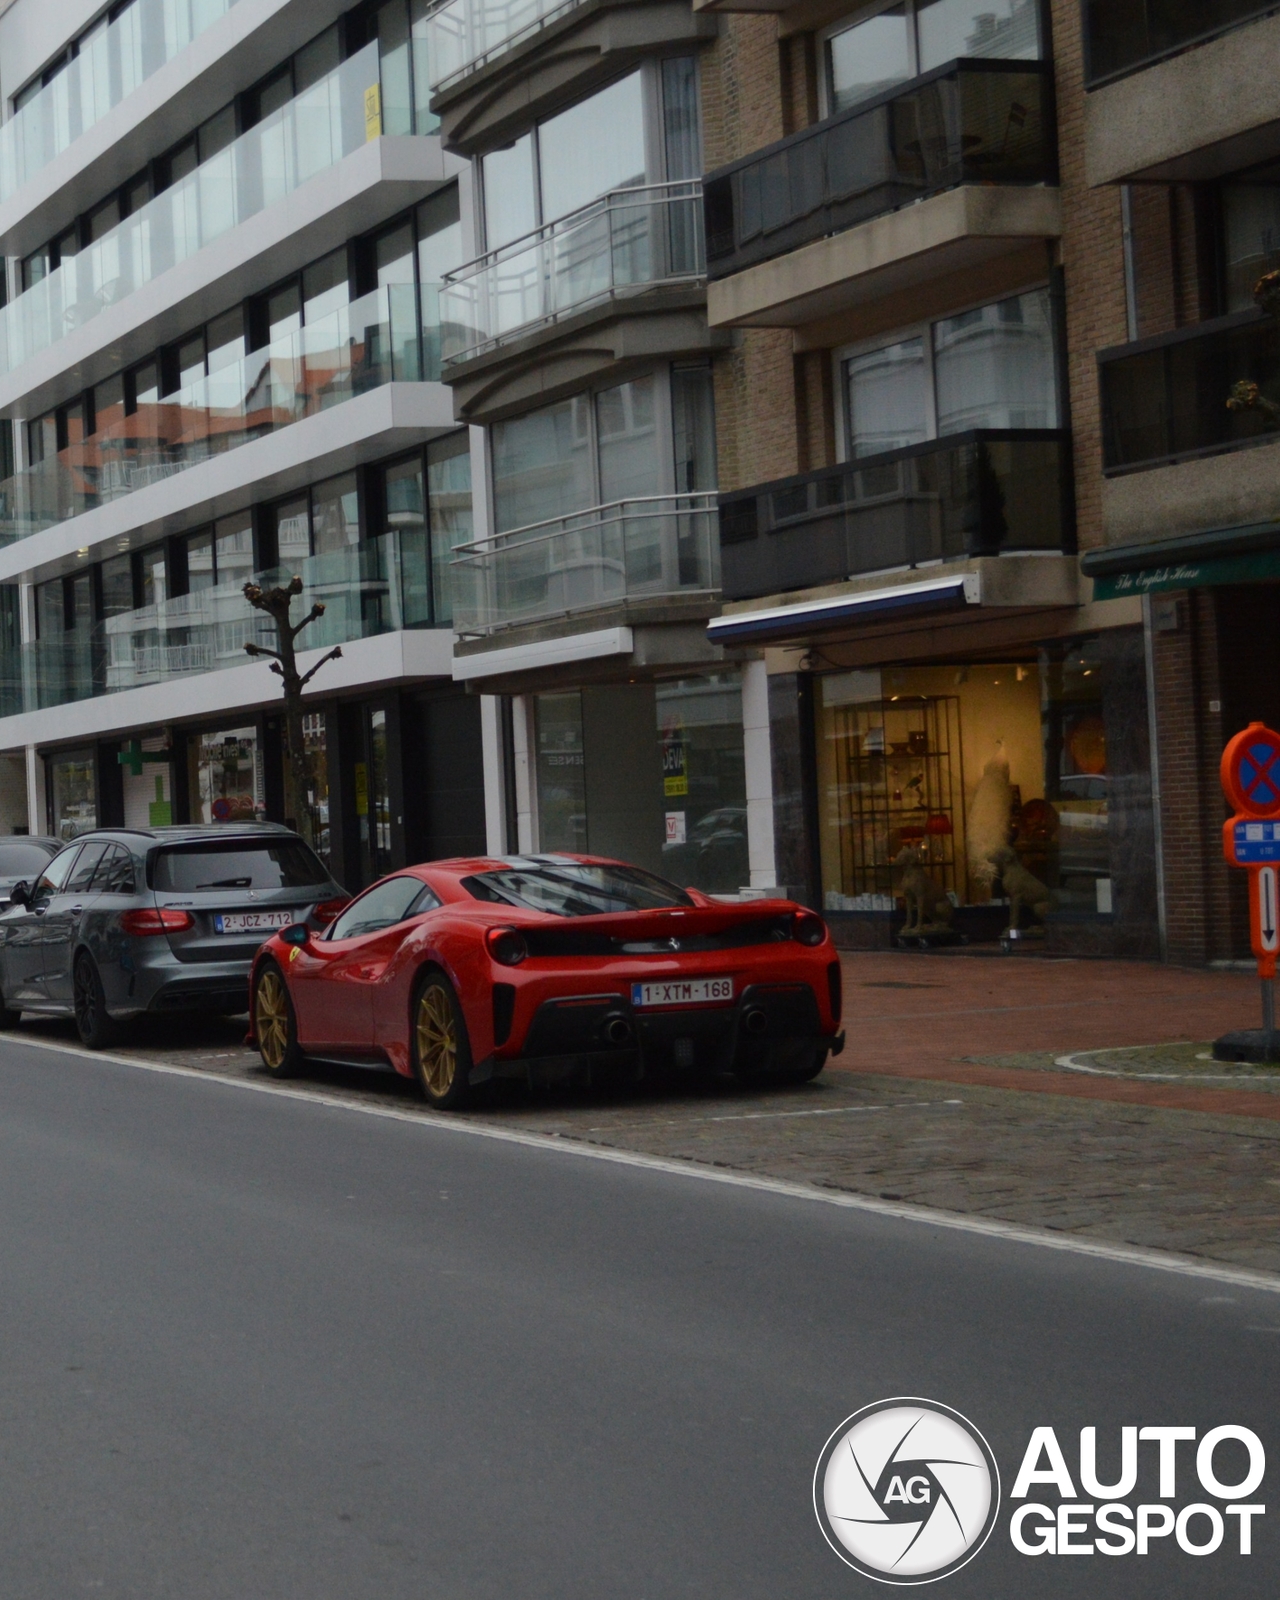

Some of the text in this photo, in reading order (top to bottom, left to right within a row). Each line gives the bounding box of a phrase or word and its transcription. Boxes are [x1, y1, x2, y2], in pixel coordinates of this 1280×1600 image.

[1115, 574, 1132, 590] The
[1136, 567, 1170, 591] English
[645, 981, 731, 1002] 1-XTM-168
